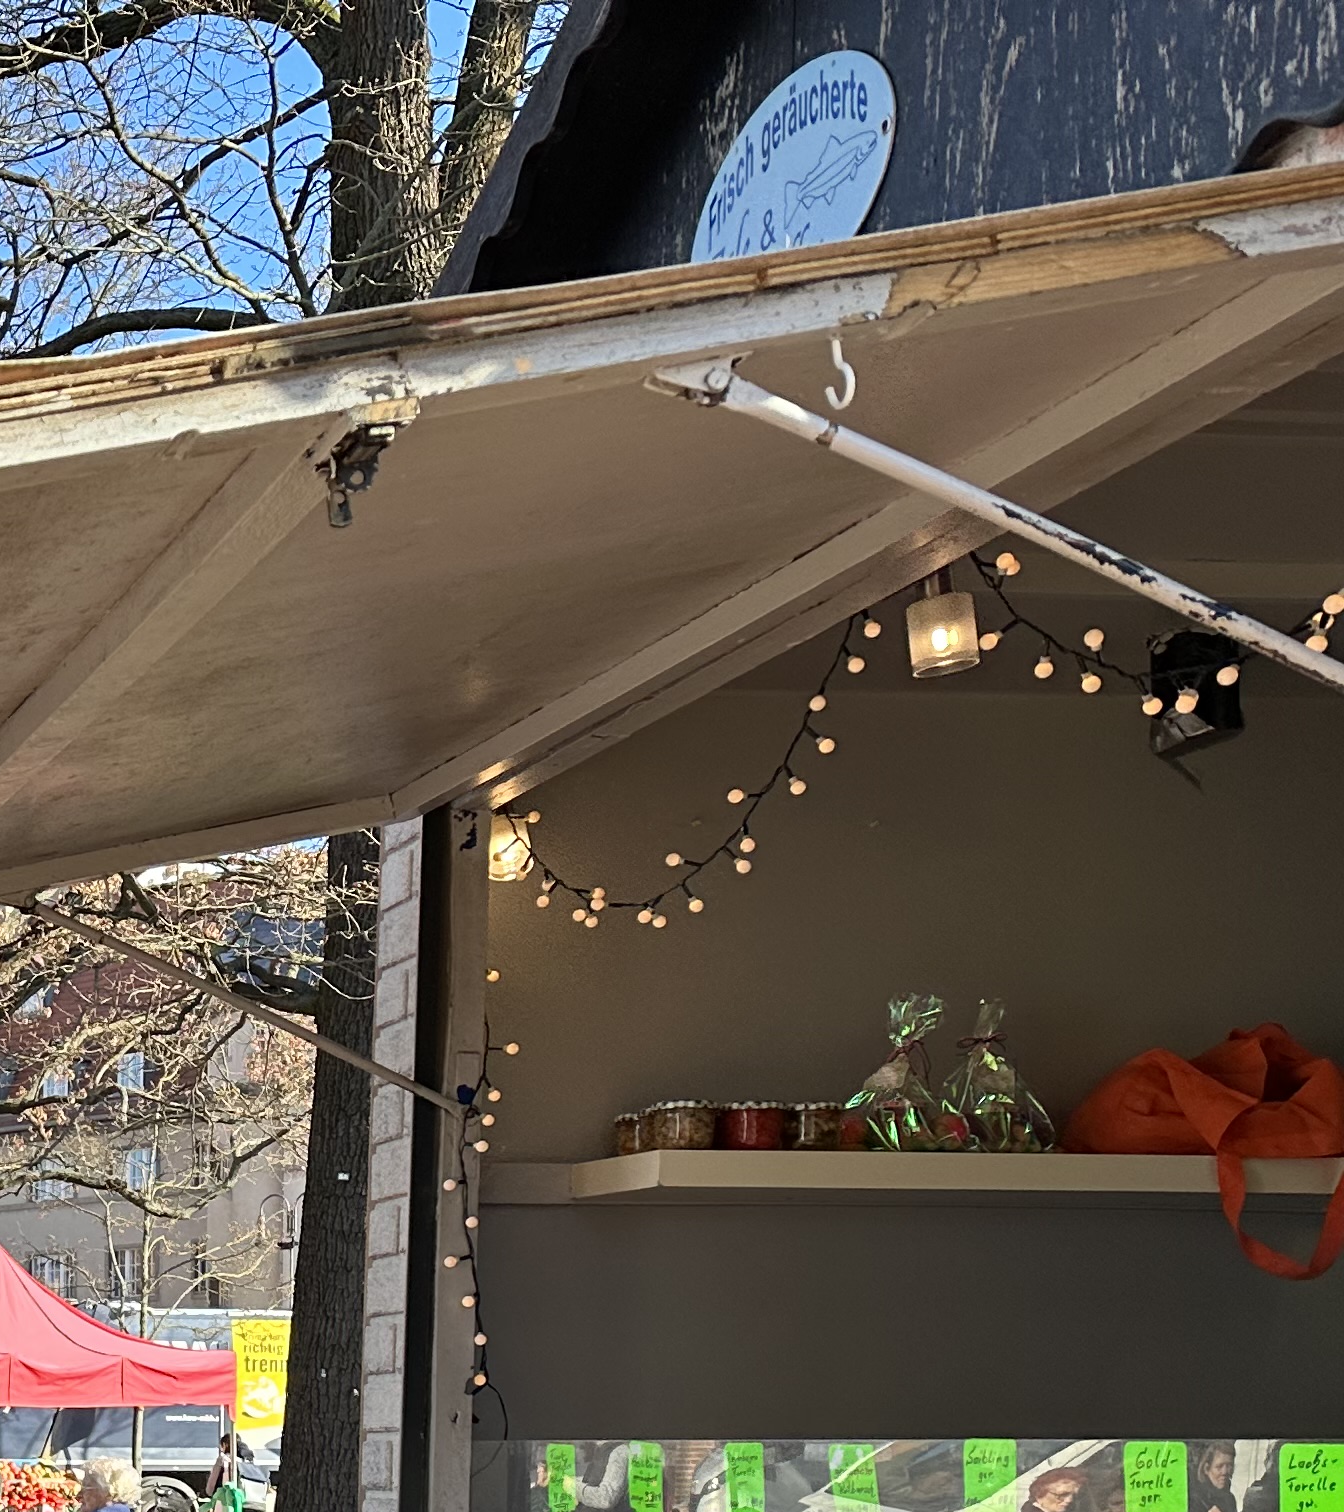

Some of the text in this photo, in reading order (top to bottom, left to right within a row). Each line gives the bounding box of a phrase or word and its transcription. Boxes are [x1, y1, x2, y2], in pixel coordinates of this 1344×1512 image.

[708, 136, 754, 254] Frisch
[760, 69, 869, 173] geräucherte
[243, 1343, 284, 1356] richtig
[965, 1445, 1010, 1468] Saibling
[1135, 1446, 1179, 1469] Gold-
[1129, 1471, 1173, 1490] Forelle
[1285, 1477, 1337, 1492] Forelle
